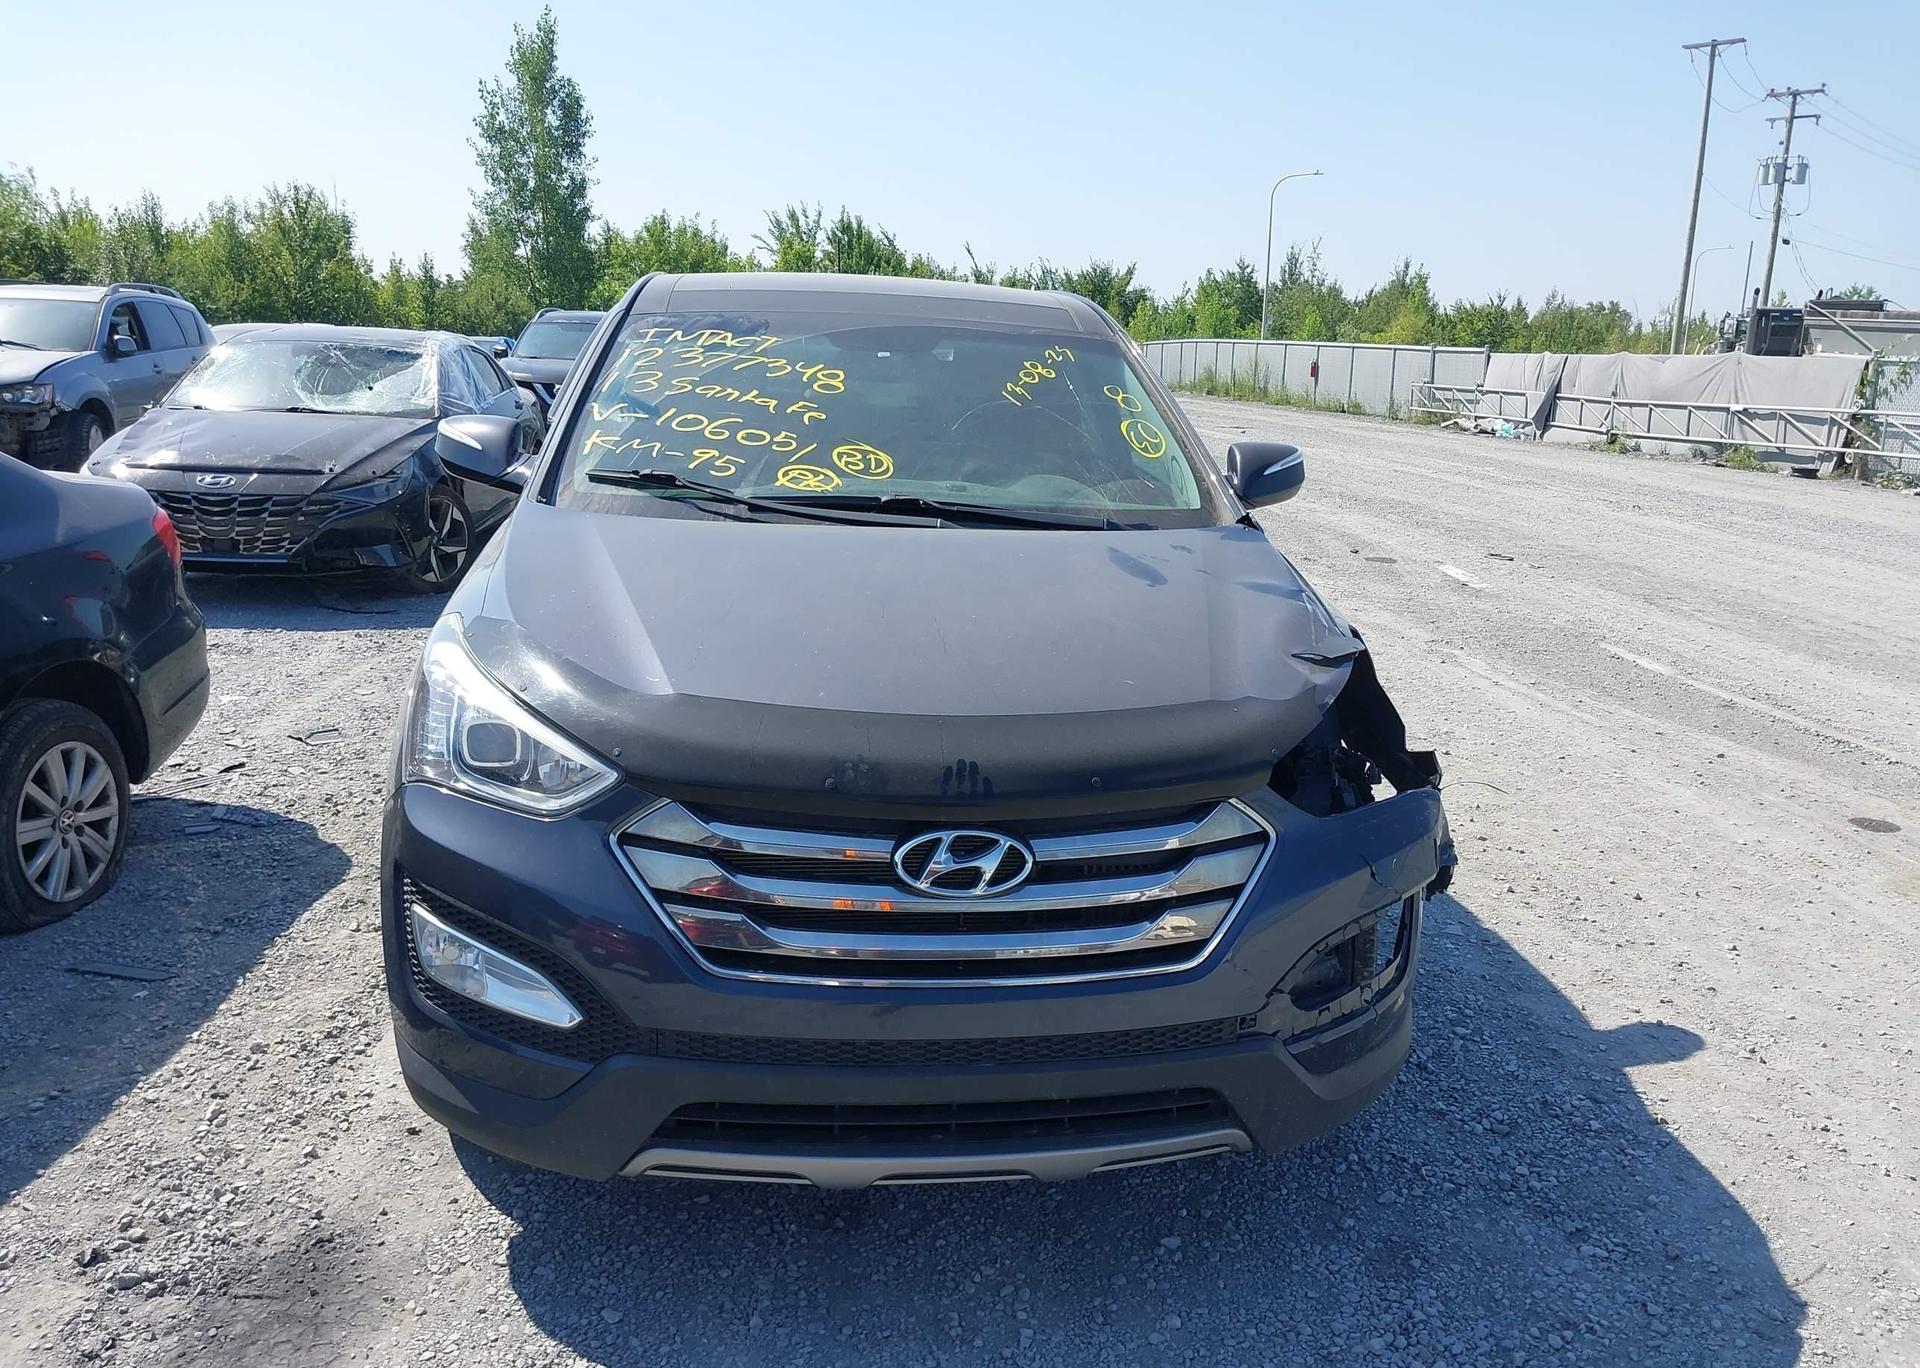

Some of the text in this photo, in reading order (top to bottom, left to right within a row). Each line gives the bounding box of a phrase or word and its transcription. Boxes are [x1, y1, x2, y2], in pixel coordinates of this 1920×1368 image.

[633, 328, 783, 352] INTACT
[664, 377, 779, 414] Santa
[786, 401, 827, 425] Fe
